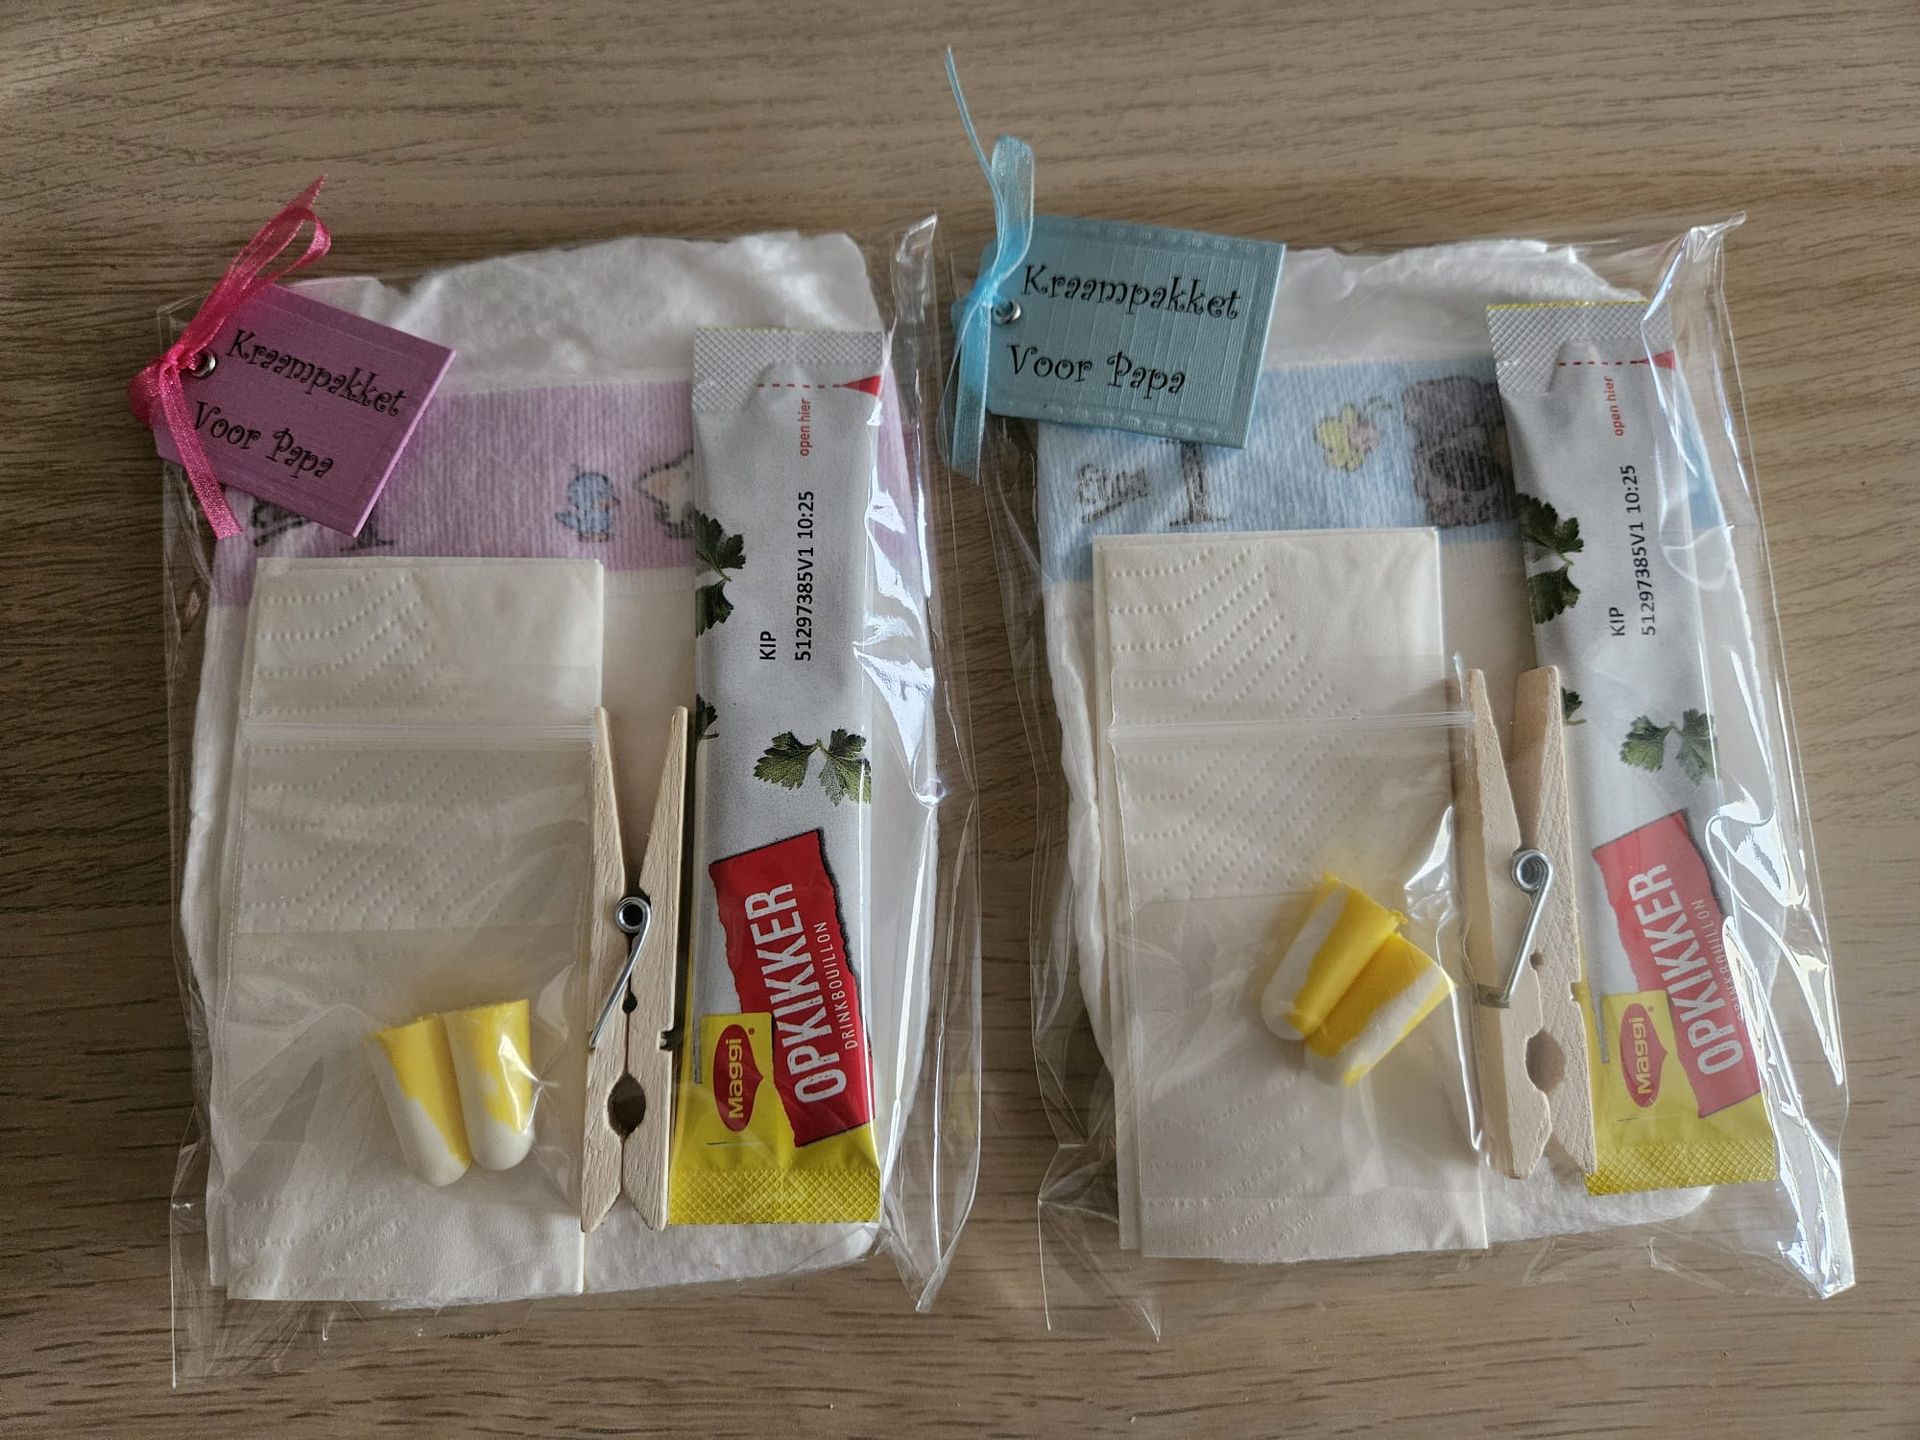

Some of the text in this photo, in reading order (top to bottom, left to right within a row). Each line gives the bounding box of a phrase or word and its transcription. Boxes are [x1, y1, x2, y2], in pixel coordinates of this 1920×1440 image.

[1021, 264, 1241, 320] Kraampakket
[225, 329, 407, 417] Kraampakket
[1007, 344, 1186, 399] Voor Papa
[1604, 376, 1625, 437] open hier
[194, 401, 334, 478] Voor Papa
[798, 397, 812, 457] open hier
[795, 491, 814, 661] 51297385V1 10:25
[1620, 465, 1656, 636] 51297385V1 10:25
[760, 630, 776, 660] KIP
[1608, 606, 1625, 637] KIP
[745, 883, 847, 1103] OPKIKKER
[813, 921, 857, 1049] DRINKBOUILLON
[1629, 863, 1743, 1076] OPKIKKER
[726, 1038, 743, 1118] Maggi
[1629, 1017, 1651, 1095] Maggi
